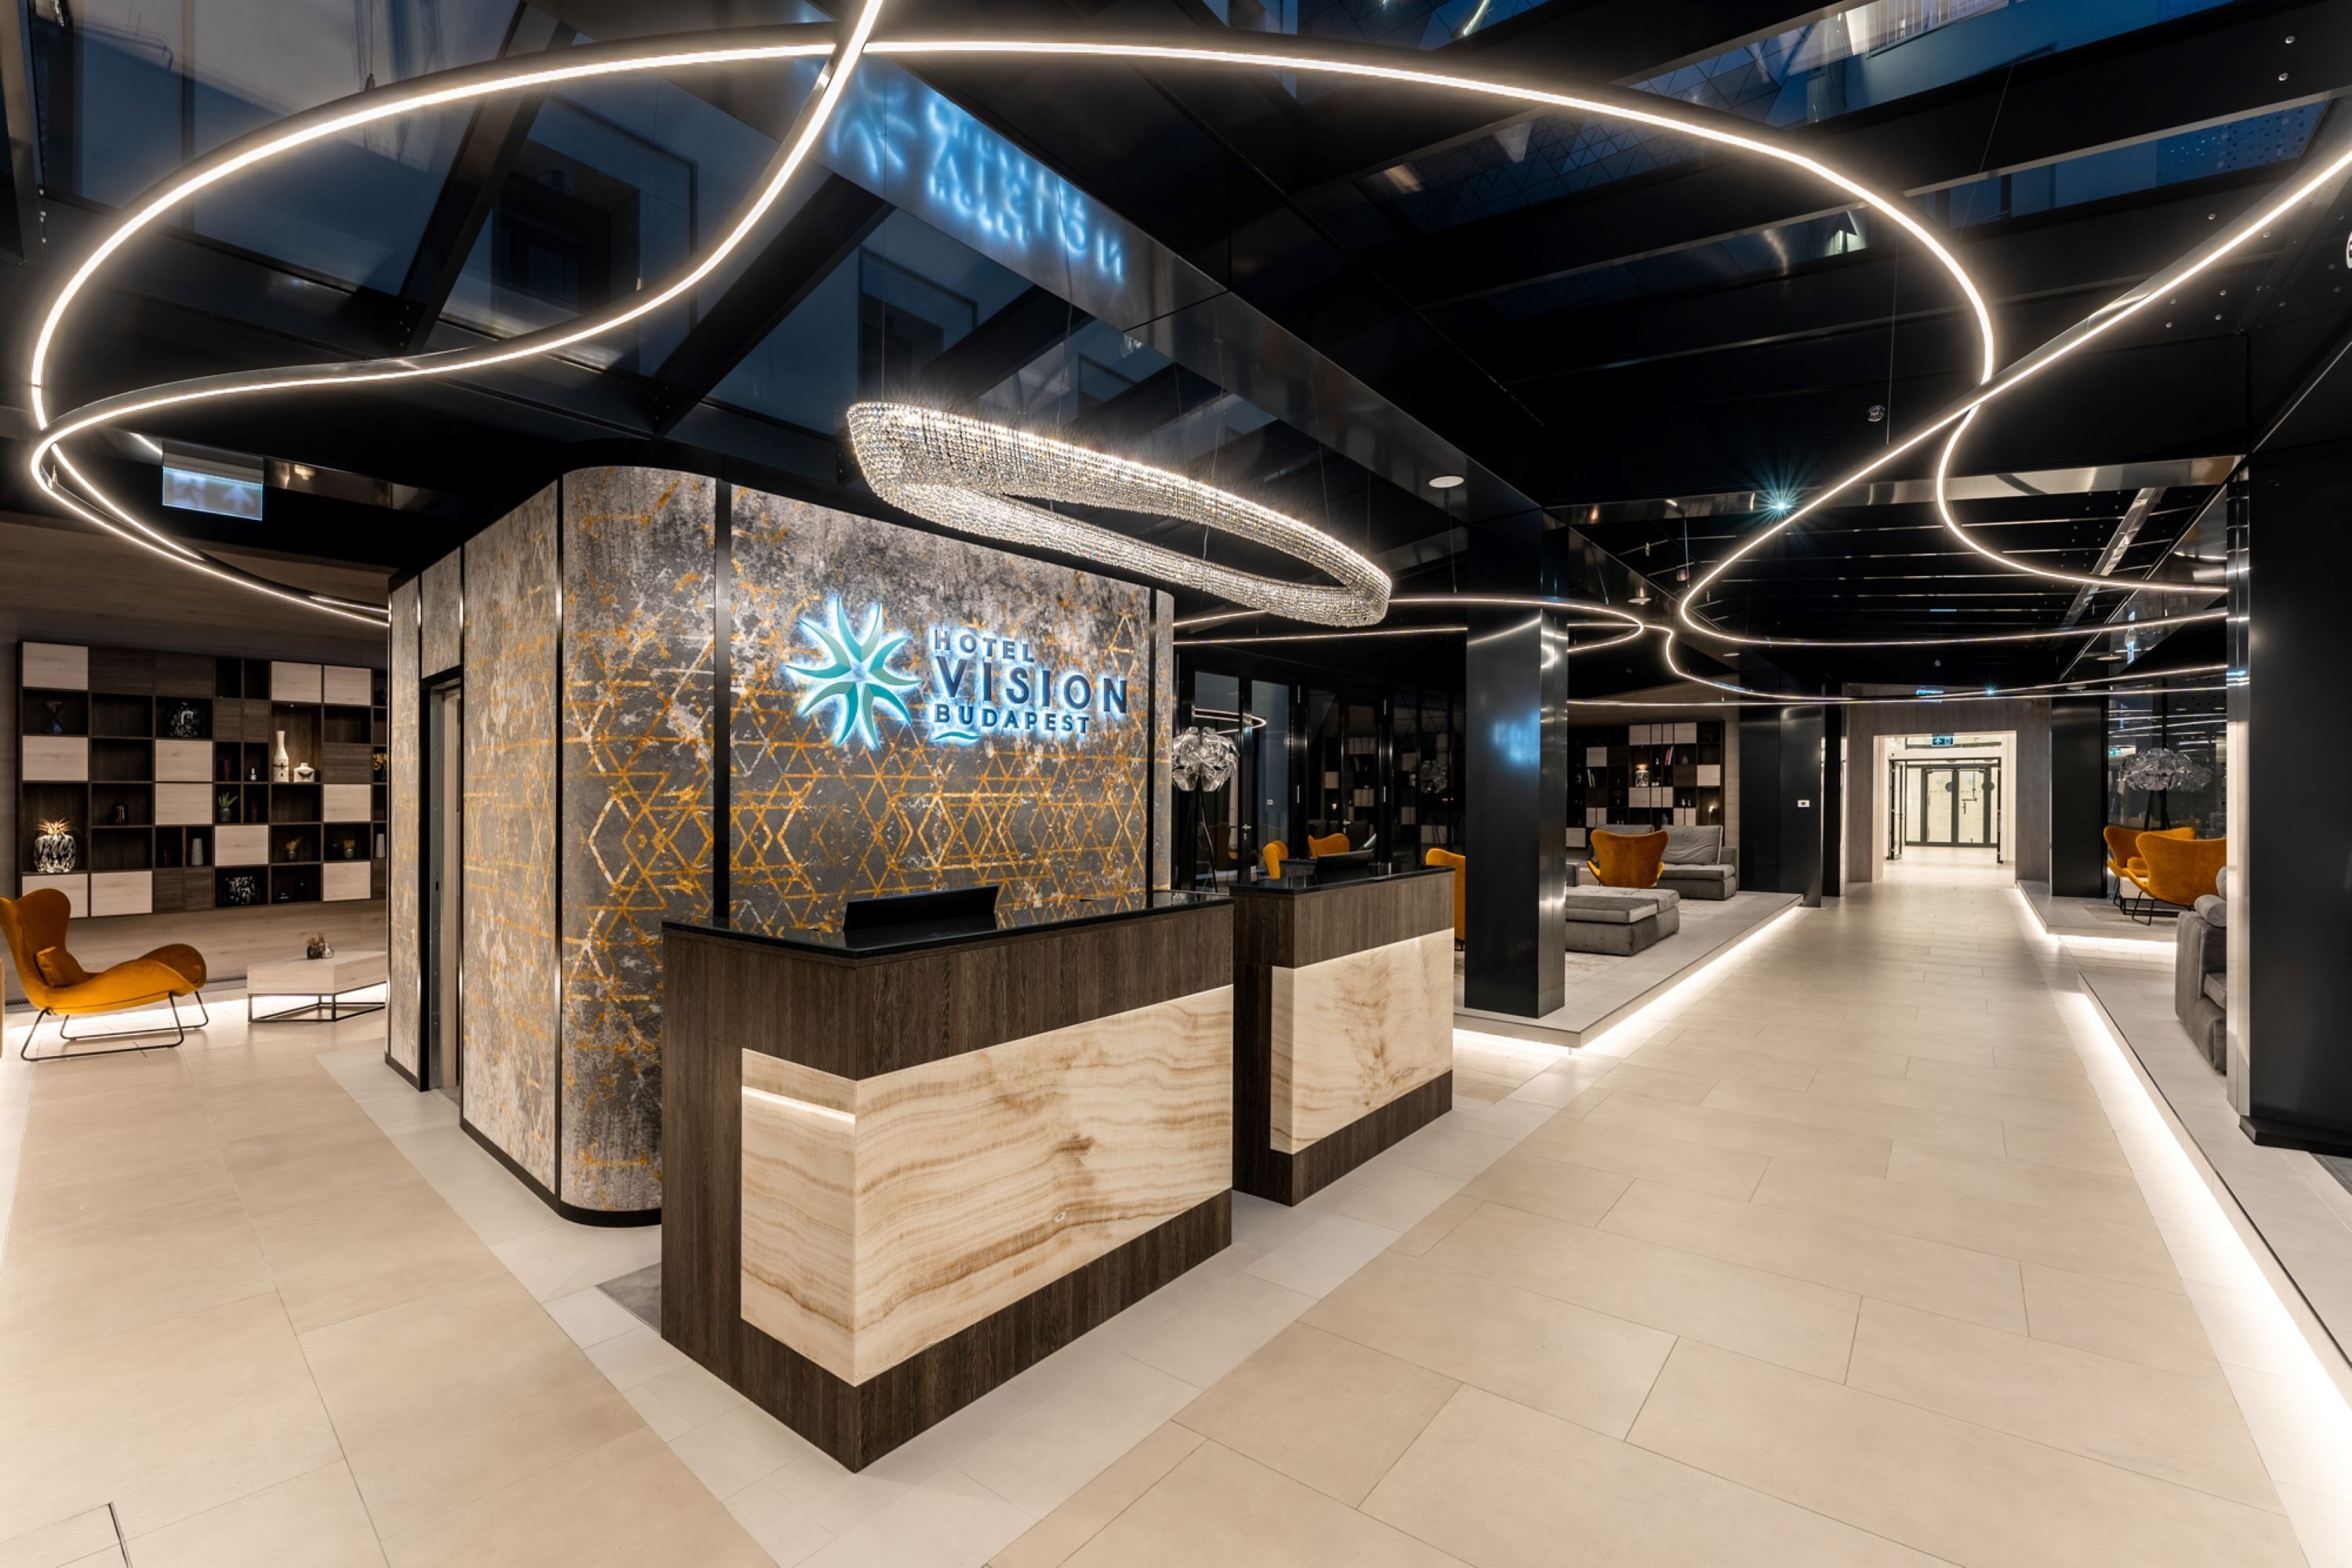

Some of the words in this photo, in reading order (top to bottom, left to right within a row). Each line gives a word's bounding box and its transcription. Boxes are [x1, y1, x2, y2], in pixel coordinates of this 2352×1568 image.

[934, 629, 1034, 662] HOTEL
[936, 655, 1127, 713] VISION
[935, 703, 1089, 733] BUDAPEST
